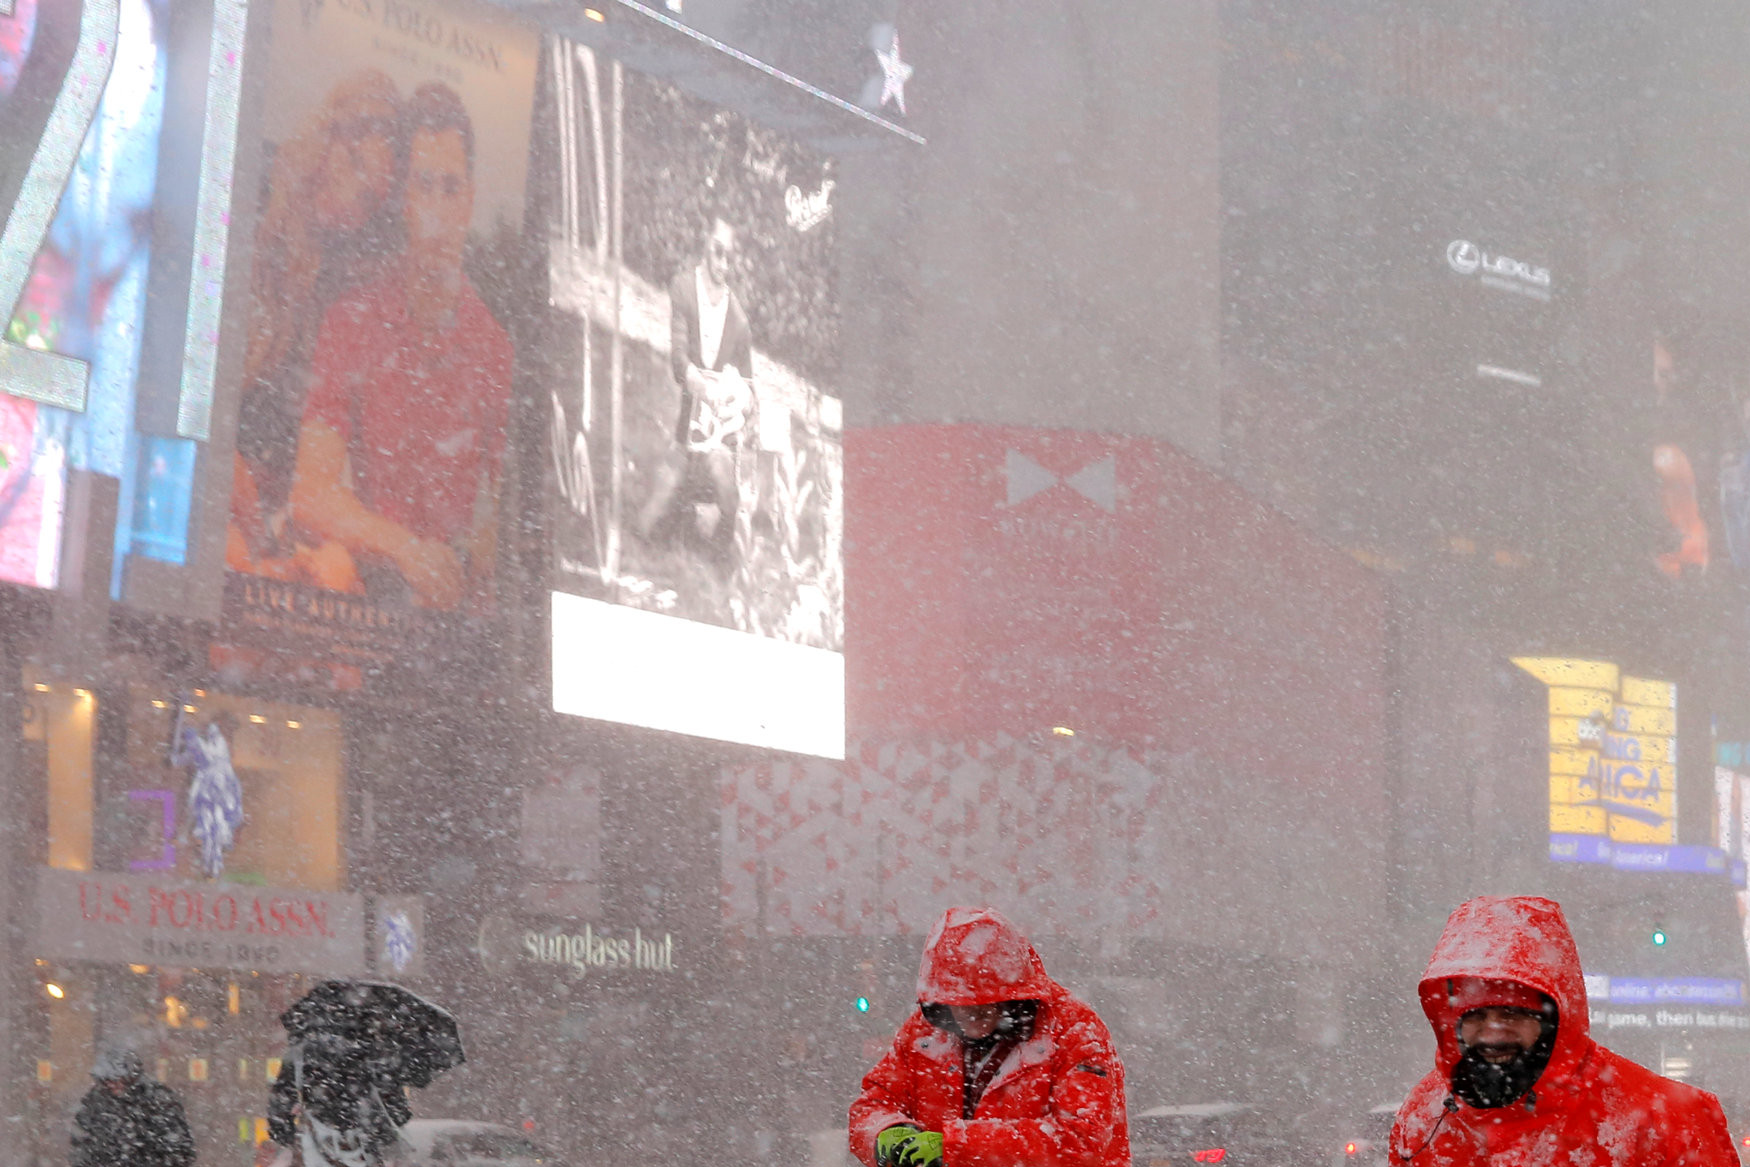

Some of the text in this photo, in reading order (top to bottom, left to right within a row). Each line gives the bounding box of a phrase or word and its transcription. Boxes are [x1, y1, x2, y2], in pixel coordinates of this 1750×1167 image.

[78, 881, 336, 939] U.S. POLO ASSN.
[523, 921, 673, 980] sunglass hut
[1656, 1009, 1693, 1026] then
